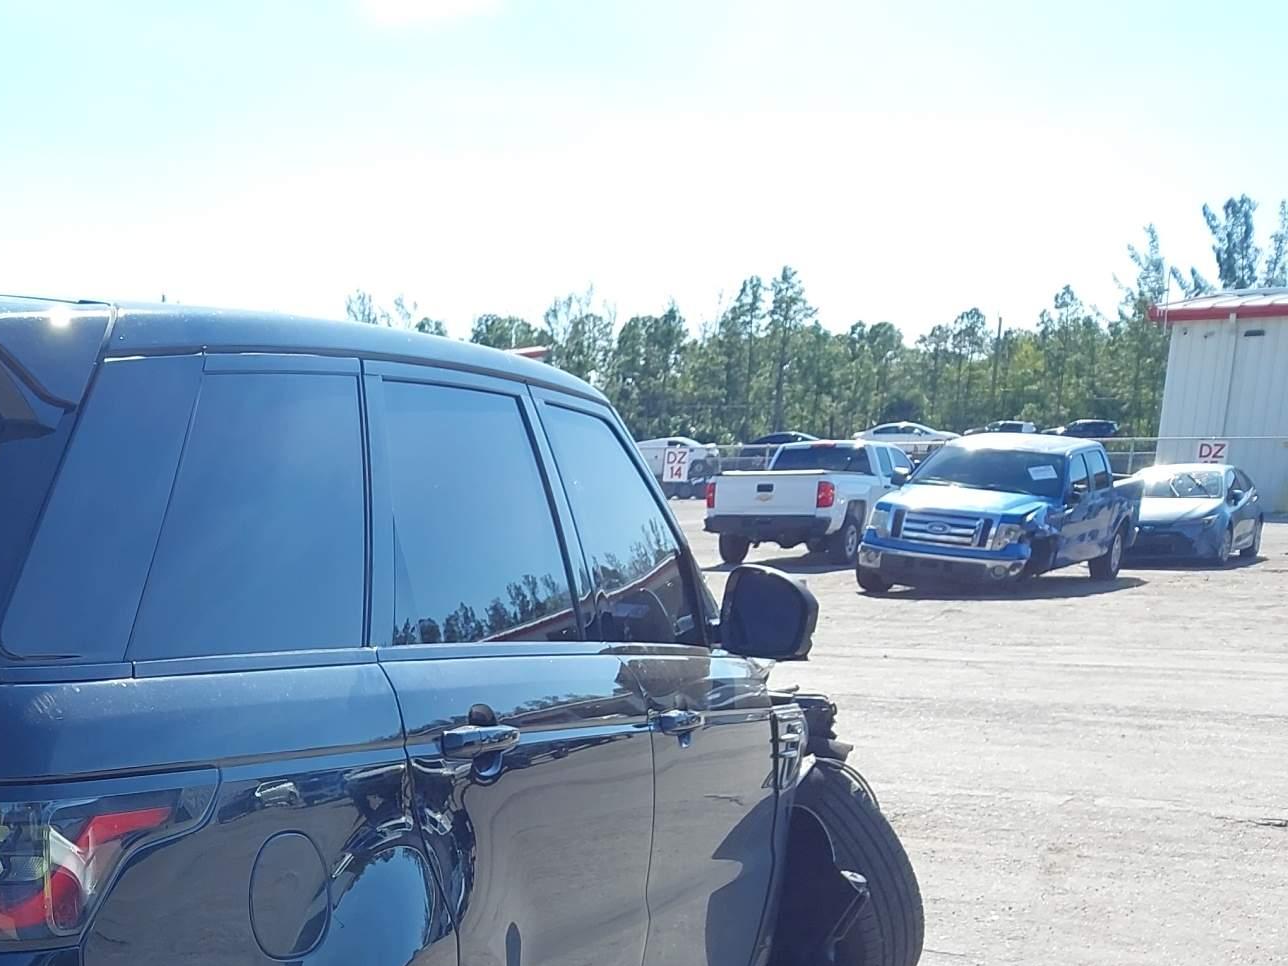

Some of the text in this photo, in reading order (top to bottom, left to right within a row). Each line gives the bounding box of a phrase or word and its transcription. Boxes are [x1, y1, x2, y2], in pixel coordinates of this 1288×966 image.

[667, 451, 687, 465] DZ
[1199, 443, 1226, 459] DZ
[670, 465, 682, 479] 14
